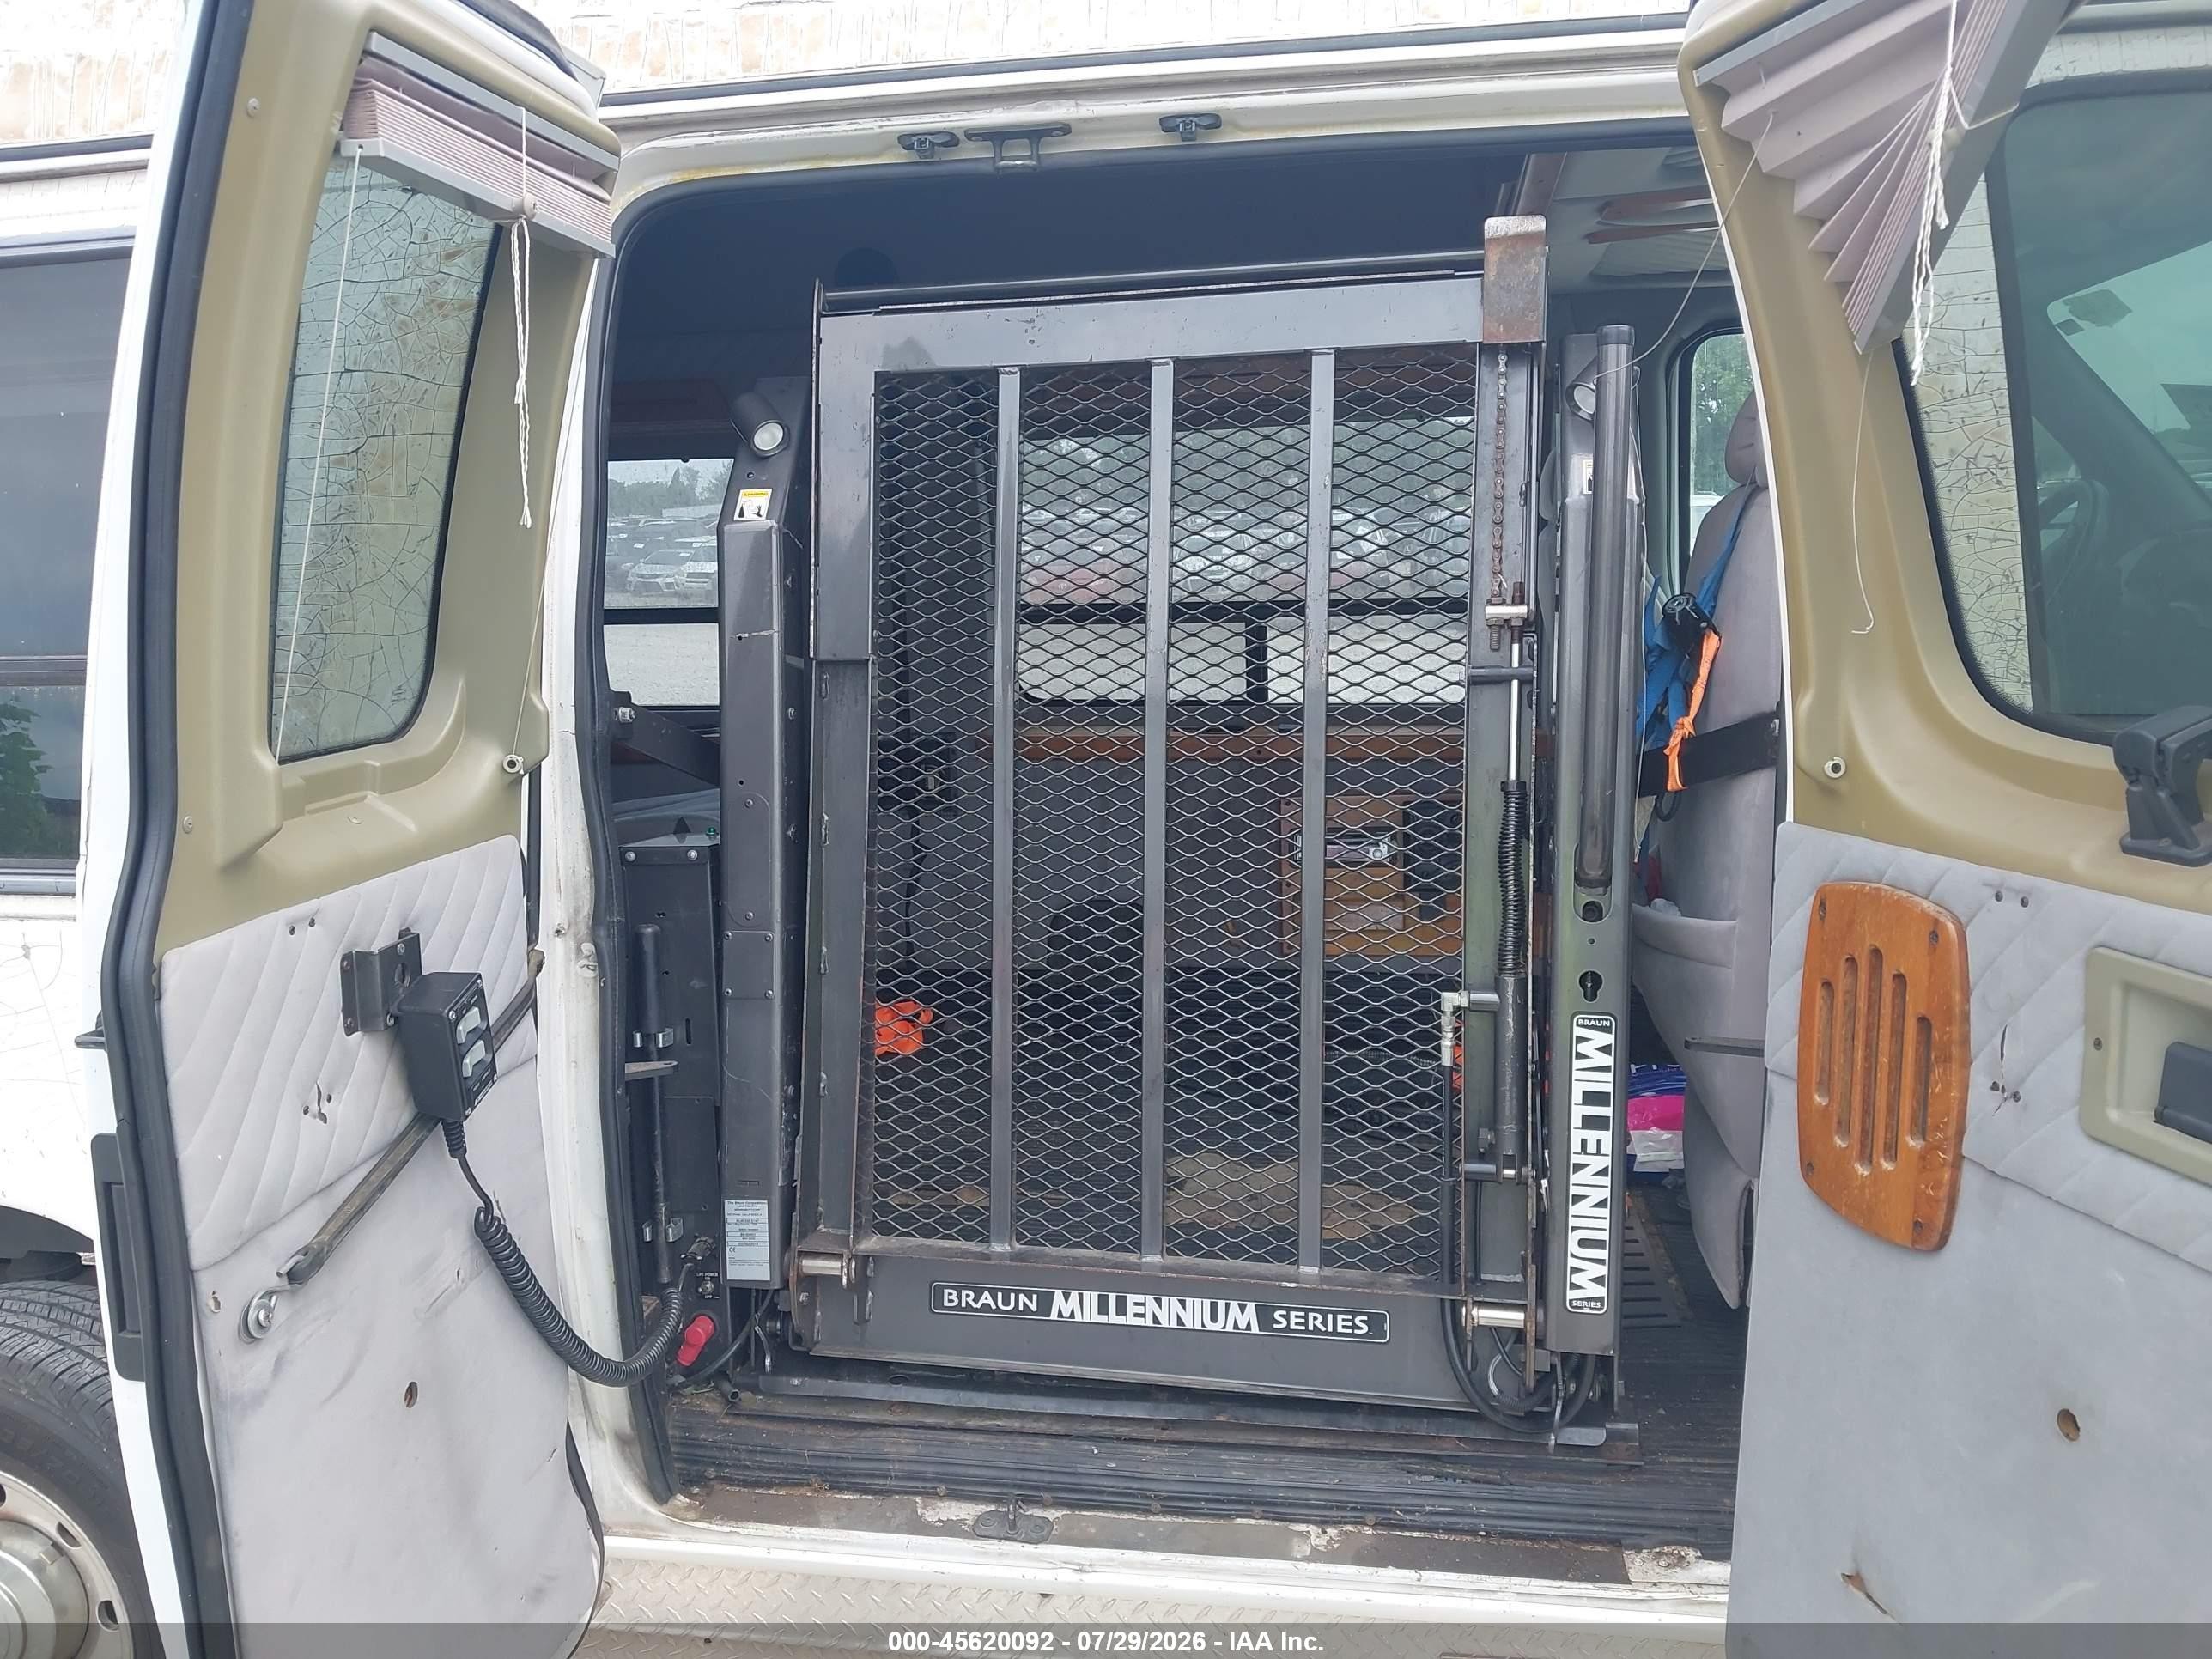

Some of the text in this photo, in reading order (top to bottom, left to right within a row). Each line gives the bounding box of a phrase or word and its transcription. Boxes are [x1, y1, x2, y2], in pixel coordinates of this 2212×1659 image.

[1569, 1026, 1613, 1299] MILLENNIUM
[943, 1289, 1370, 1334] BRAUN MILLENNIUM SERIES
